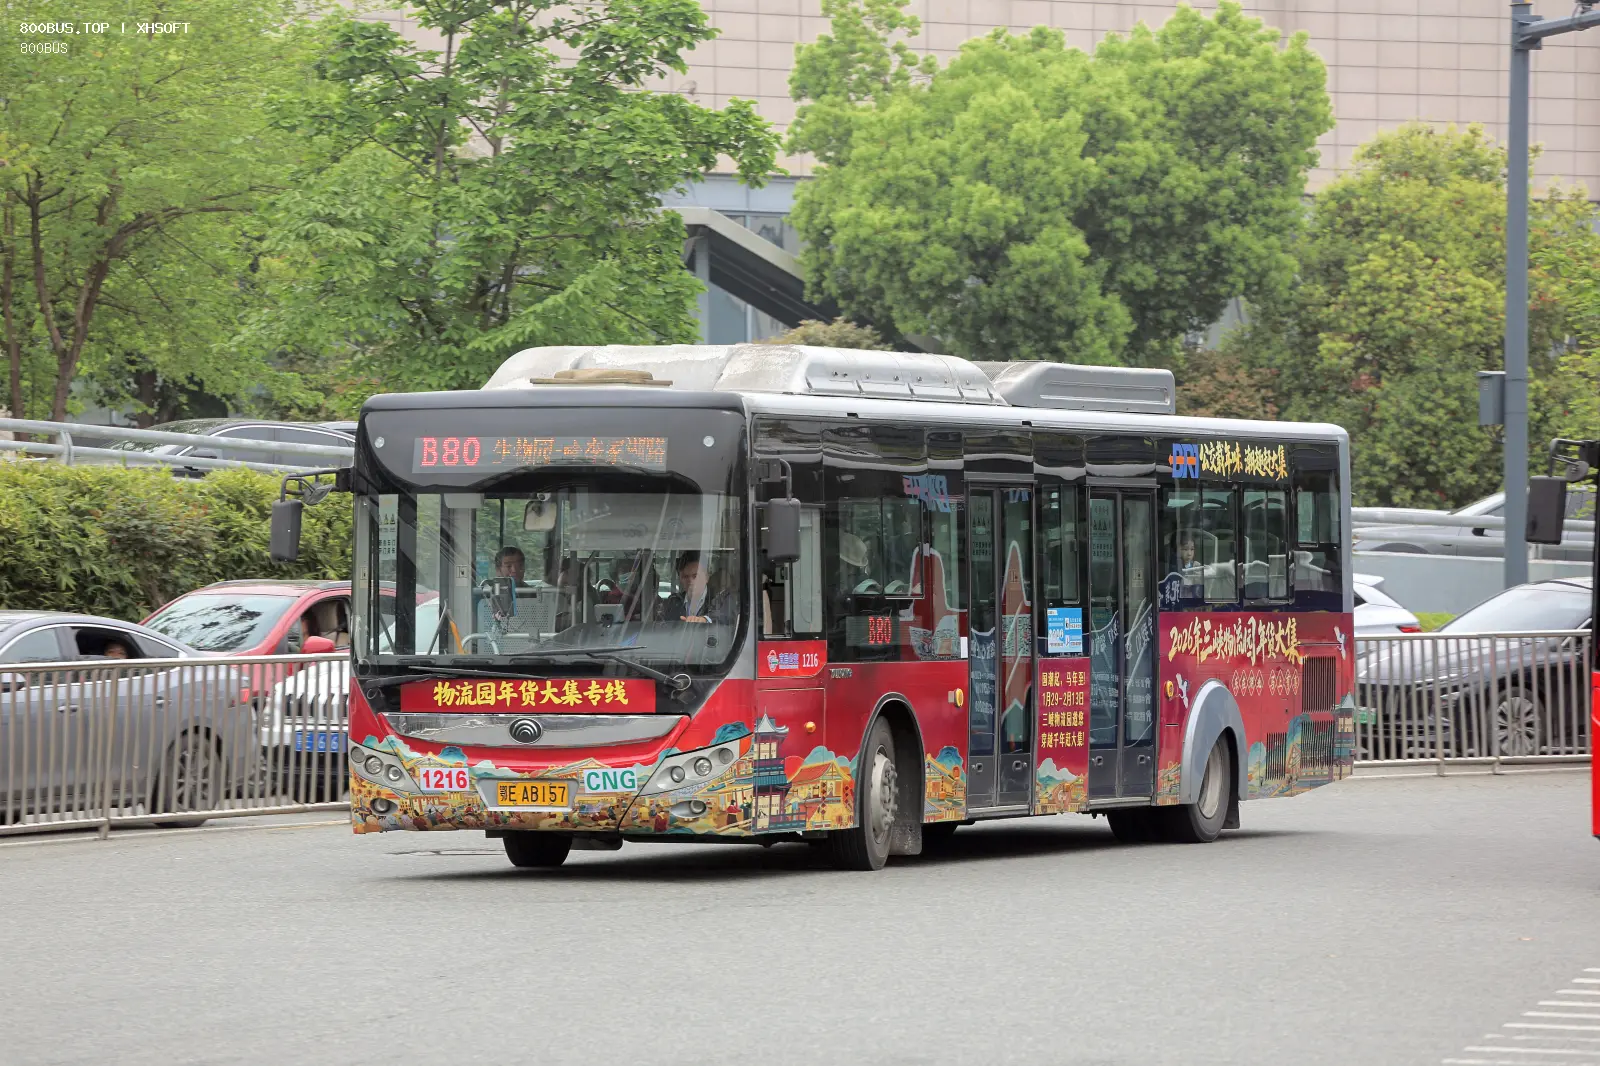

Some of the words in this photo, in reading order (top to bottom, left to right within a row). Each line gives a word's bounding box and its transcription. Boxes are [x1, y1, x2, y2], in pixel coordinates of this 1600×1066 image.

[420, 437, 481, 466] B80
[868, 615, 892, 645] B80
[802, 653, 819, 668] 1216
[433, 679, 629, 707] 物流园年货大集专线
[1042, 691, 1084, 707] 1月29-2月13日
[1042, 711, 1084, 727] 三峡物流园邀您
[422, 769, 468, 789] 1216
[586, 770, 636, 791] CNG
